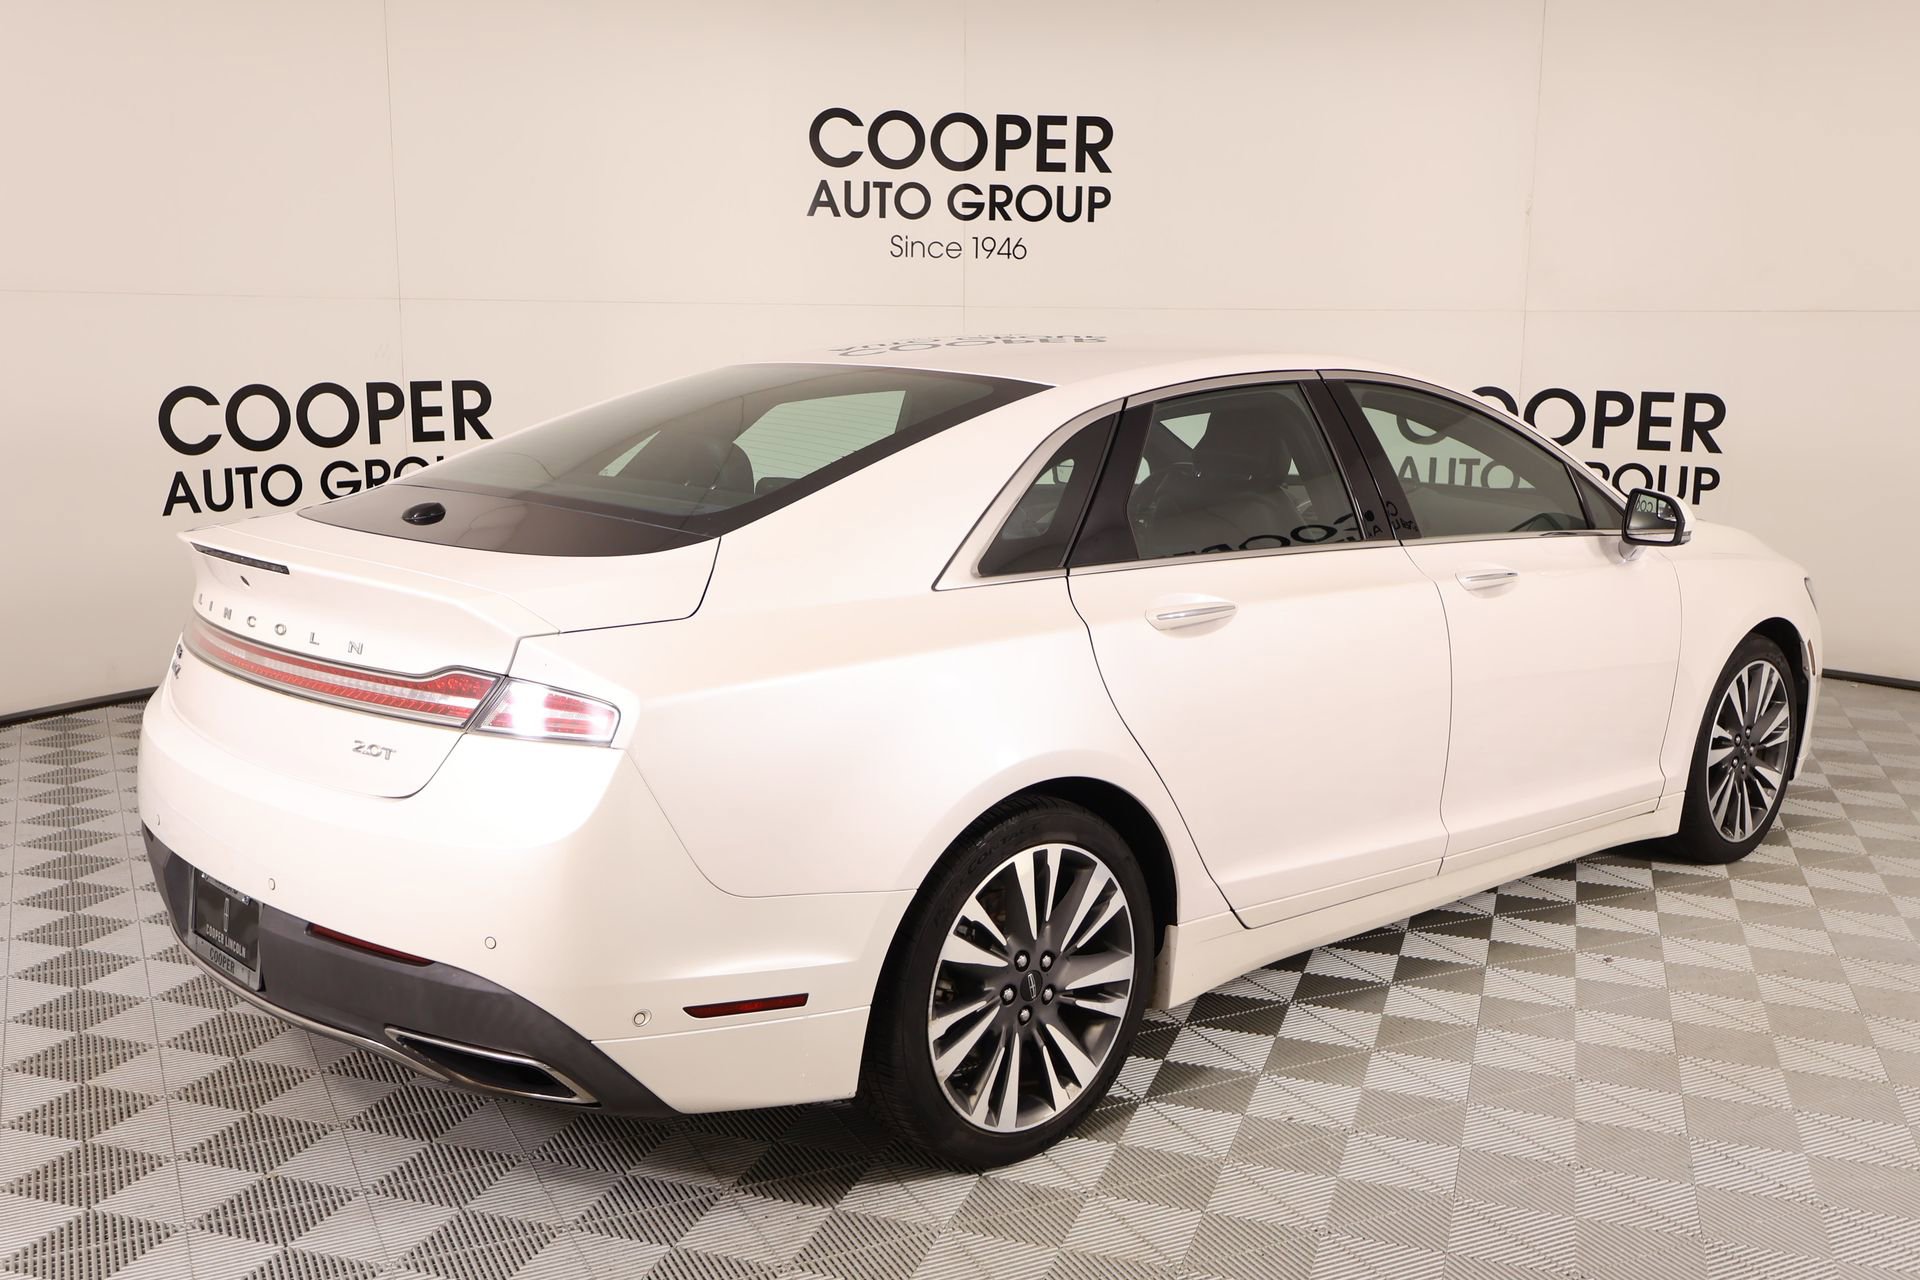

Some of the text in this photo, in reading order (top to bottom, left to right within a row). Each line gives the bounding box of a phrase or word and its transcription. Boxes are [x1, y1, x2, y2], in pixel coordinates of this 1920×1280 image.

[809, 107, 1114, 173] COOPER
[806, 180, 1112, 223] AUTO GROUP
[890, 234, 1028, 260] Since 1946
[158, 379, 495, 456] COOPER
[163, 463, 303, 516] AUTO
[1585, 461, 1721, 505] OUP
[198, 593, 364, 655] LINCOLN
[205, 923, 246, 958] COOPER LINCOLN
[209, 946, 236, 974] COOPER
